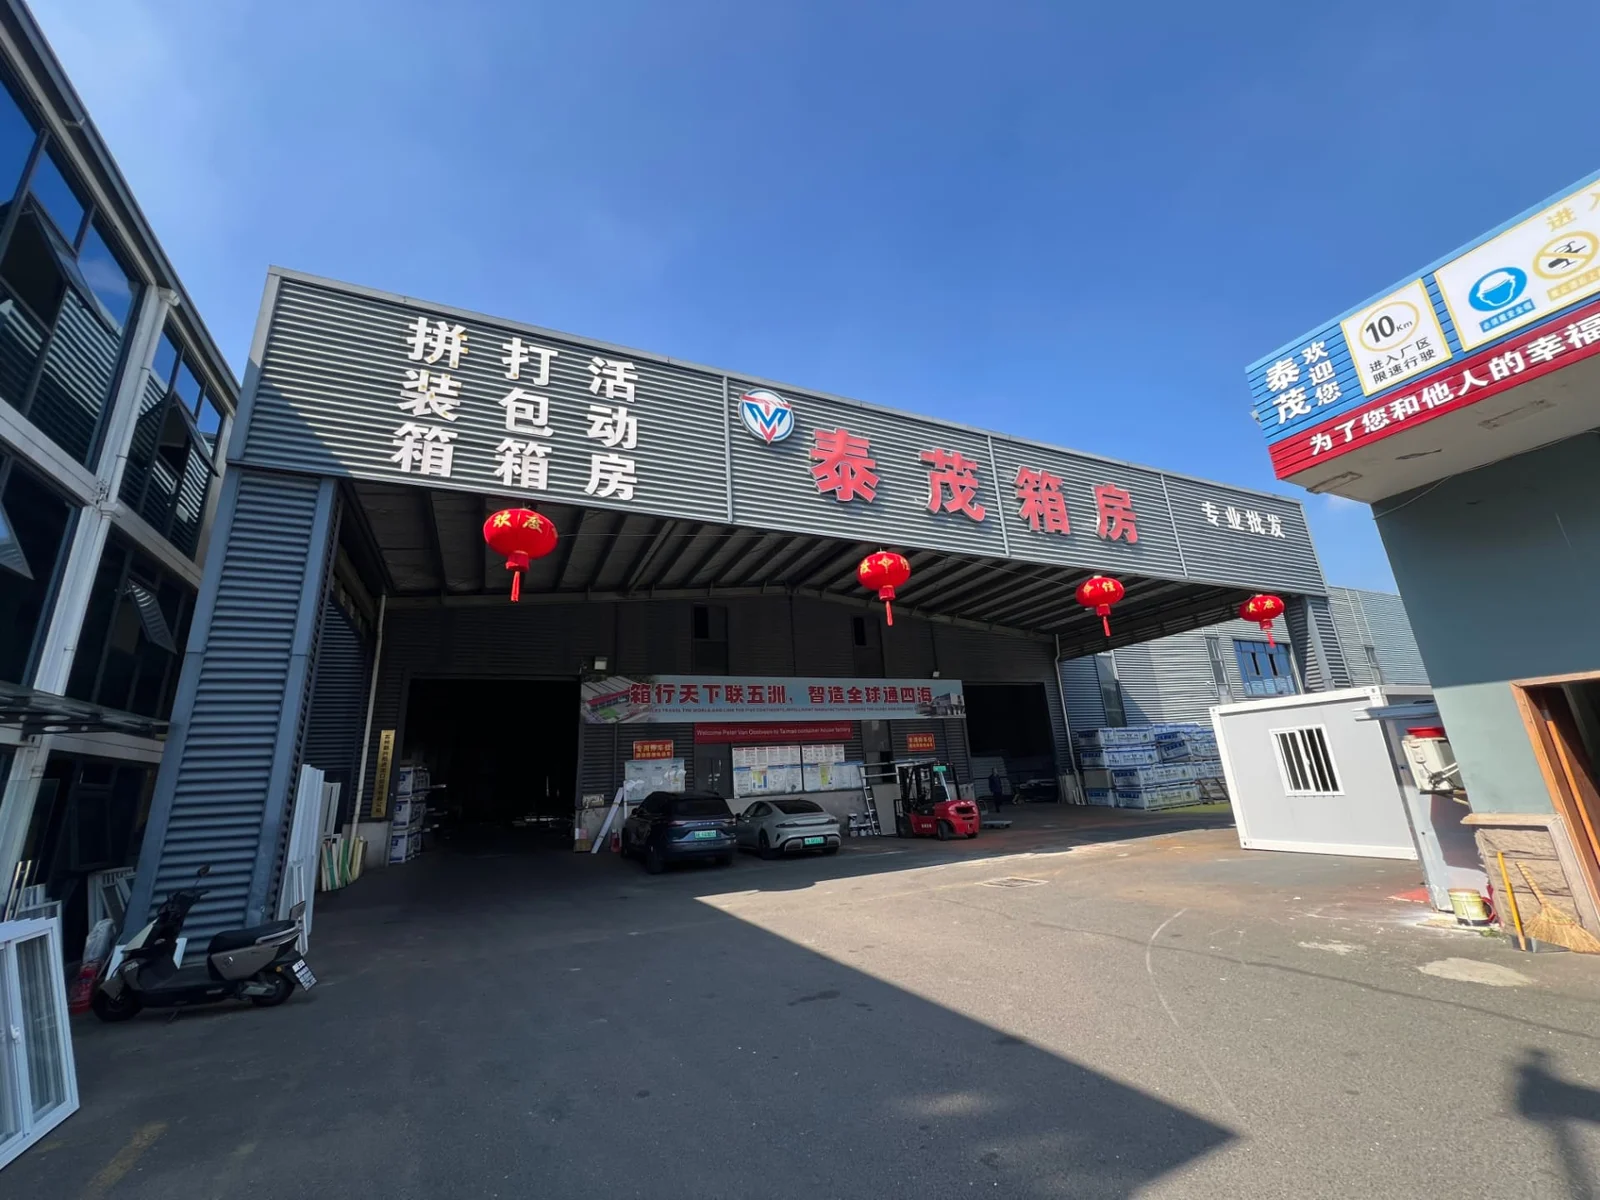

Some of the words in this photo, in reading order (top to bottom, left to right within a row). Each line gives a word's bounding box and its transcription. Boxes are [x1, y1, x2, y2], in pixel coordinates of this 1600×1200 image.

[1301, 340, 1342, 406] 欢迎您
[1369, 337, 1431, 374] 进入厂区
[1373, 349, 1437, 385] 限速行驶
[390, 316, 469, 478] 拼装箱
[493, 336, 559, 491] 打包箱
[1266, 357, 1311, 424] 泰茂
[584, 356, 639, 501] 活动房
[808, 428, 1138, 544] 泰茂箱房
[1201, 501, 1286, 538] 专业批发
